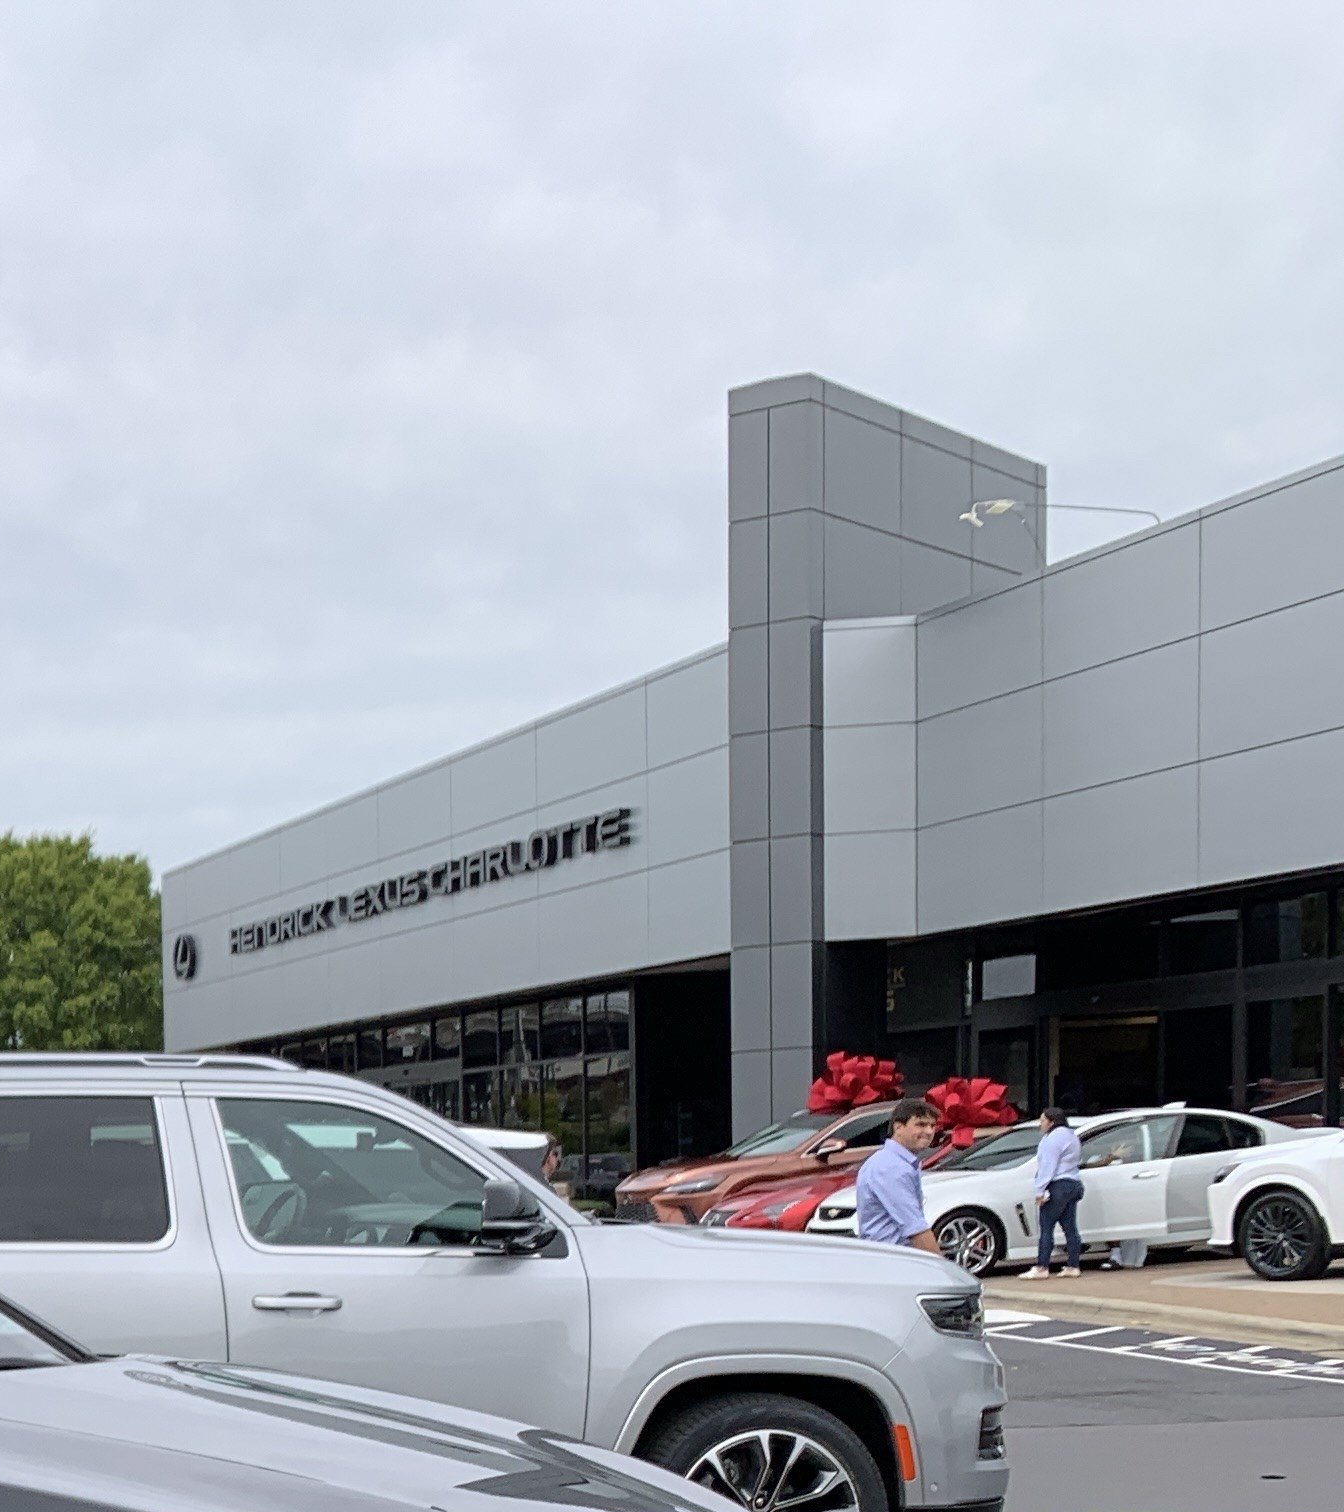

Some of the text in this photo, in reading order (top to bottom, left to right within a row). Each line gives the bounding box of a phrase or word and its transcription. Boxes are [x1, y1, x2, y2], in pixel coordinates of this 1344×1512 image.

[228, 806, 632, 955] HENDRICK LEXUS CHARLOTTE
